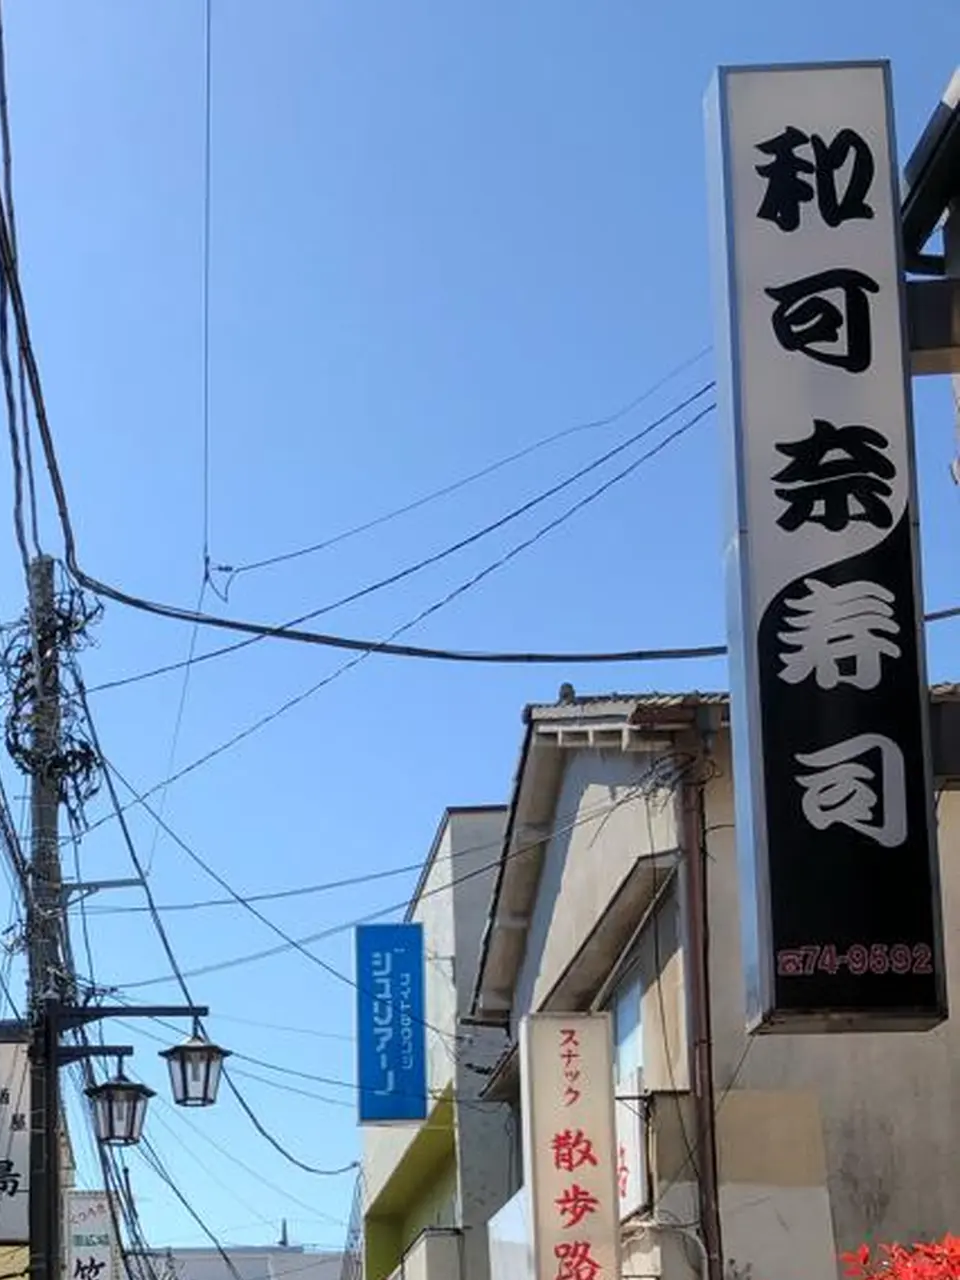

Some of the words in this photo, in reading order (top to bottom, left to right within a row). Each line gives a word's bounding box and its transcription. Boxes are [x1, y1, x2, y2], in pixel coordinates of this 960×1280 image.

[754, 124, 910, 850] 和可奈寿司
[560, 1028, 581, 1108] スナック
